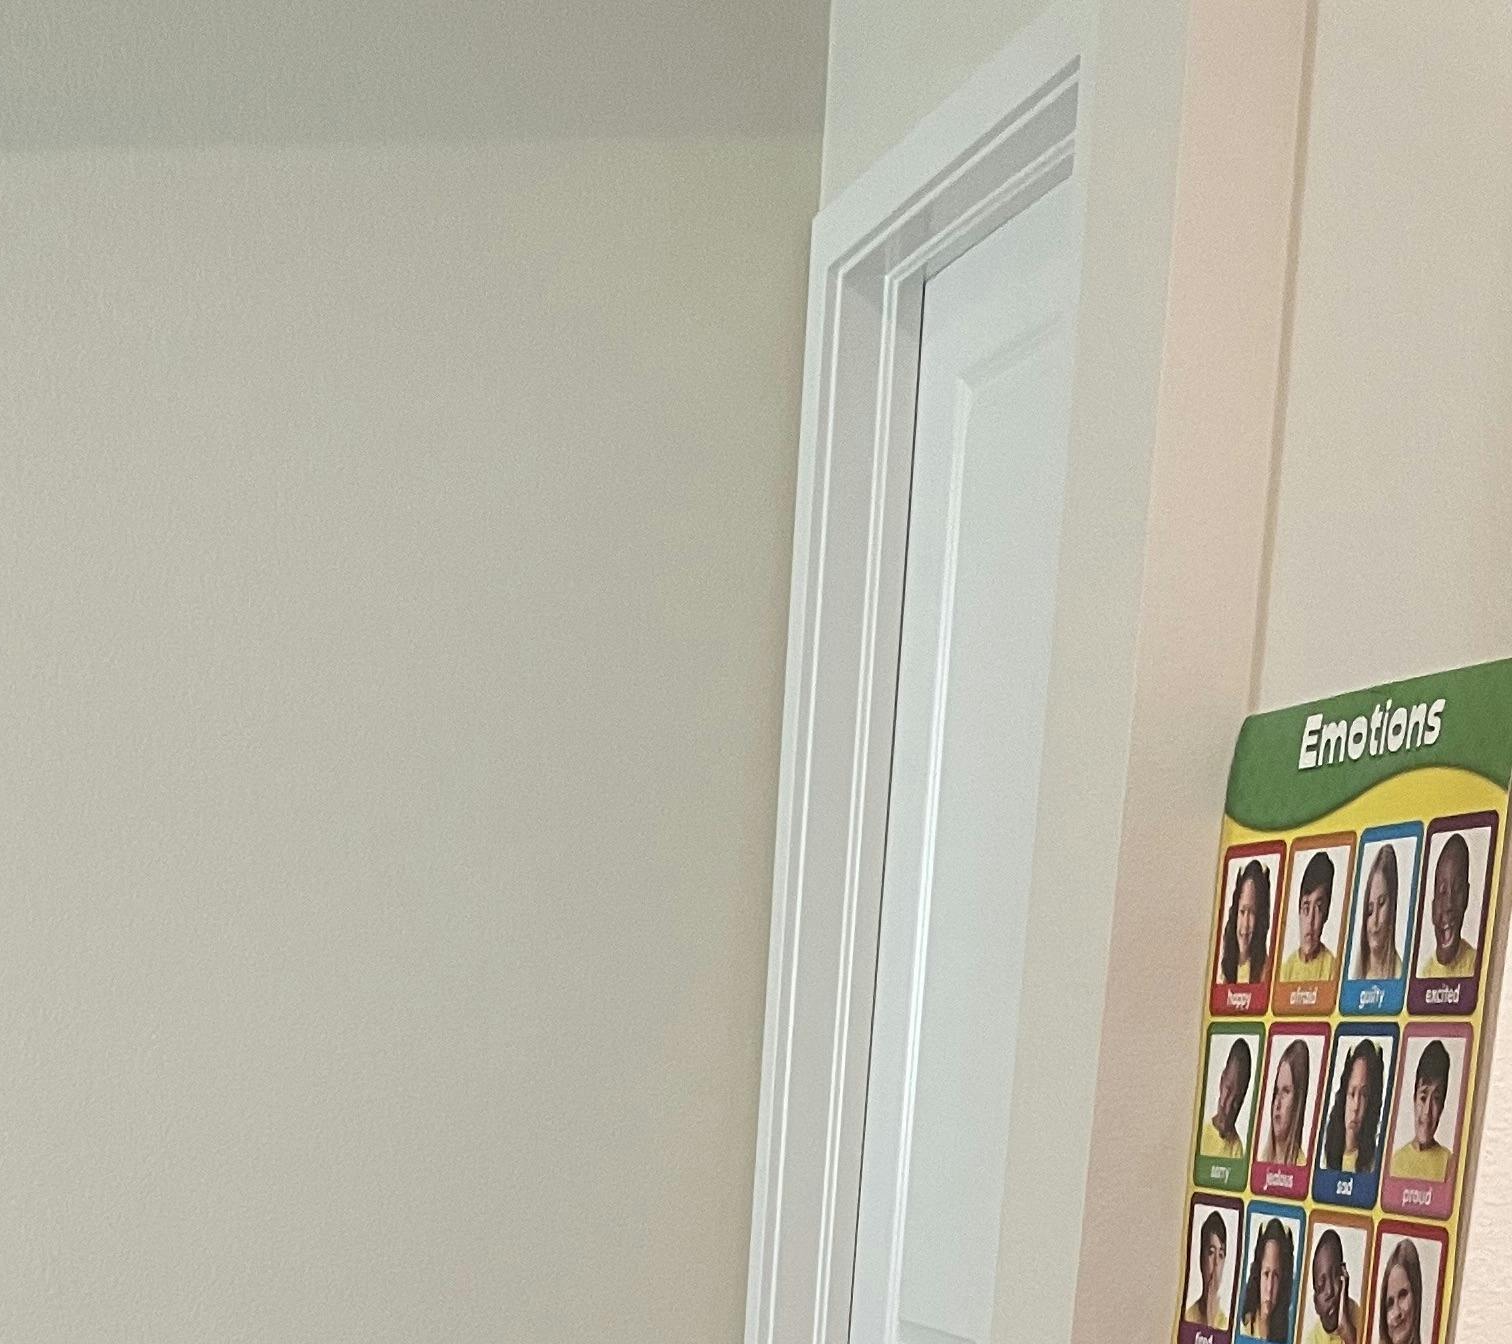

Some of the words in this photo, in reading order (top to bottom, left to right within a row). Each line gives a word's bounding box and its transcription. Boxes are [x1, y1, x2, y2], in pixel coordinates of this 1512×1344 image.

[1298, 698, 1446, 770] Emotions
[1425, 983, 1461, 1004] excited
[1335, 1177, 1354, 1196] sad
[1401, 1186, 1433, 1207] proud
